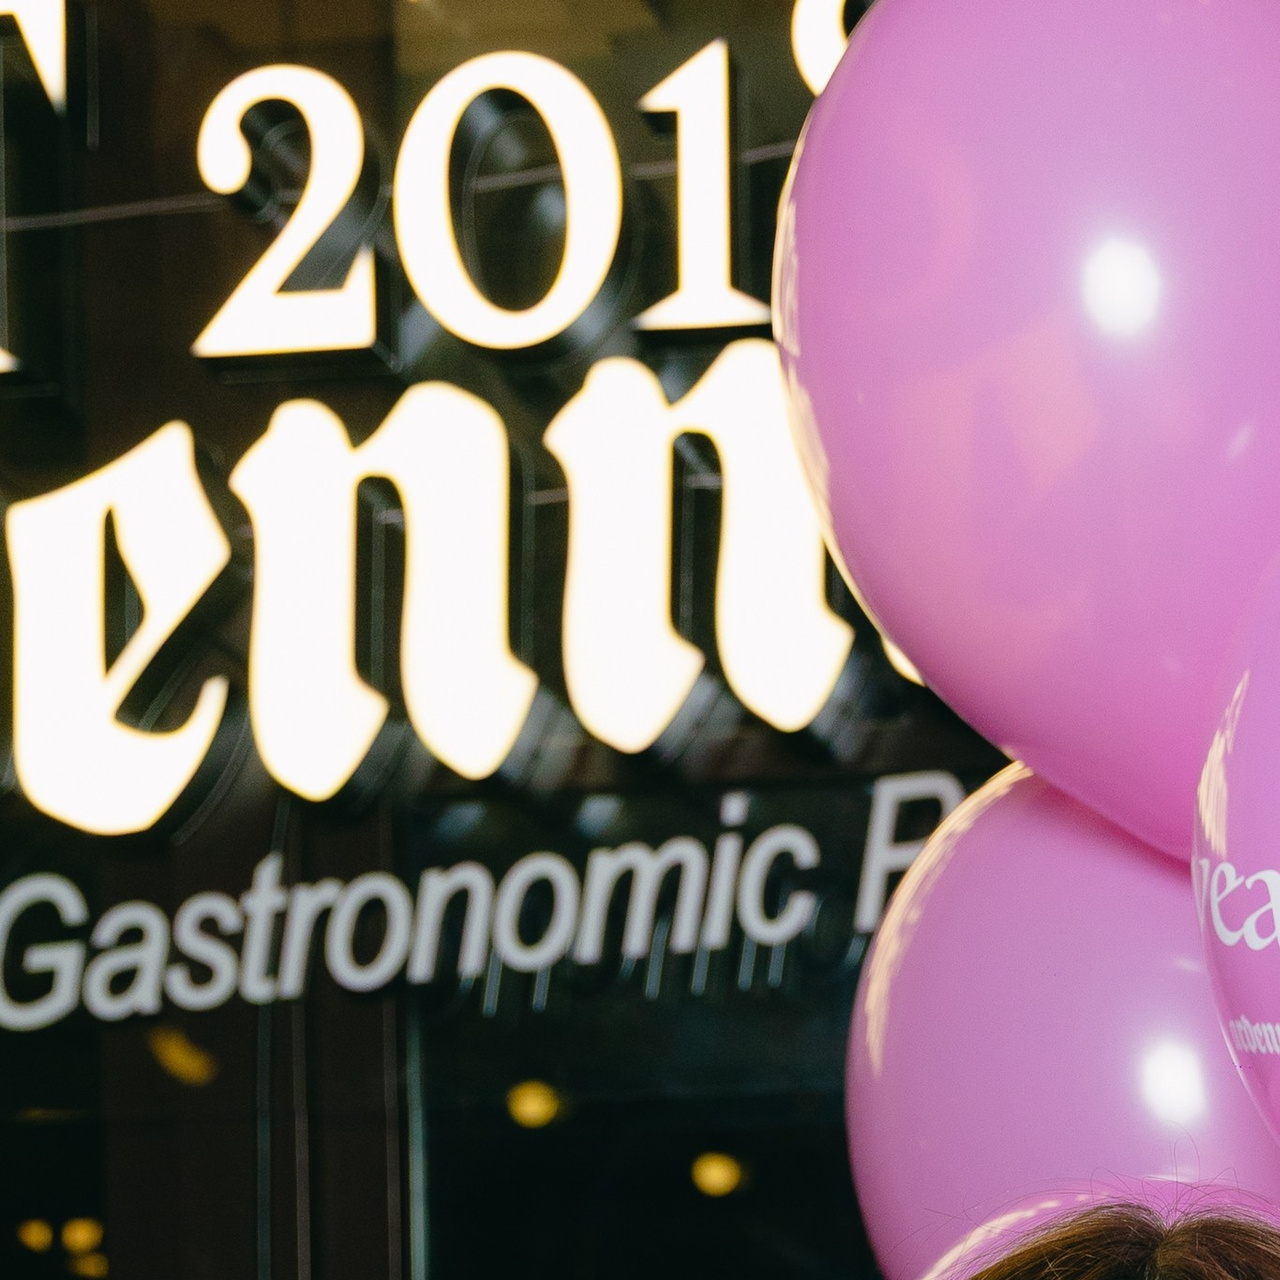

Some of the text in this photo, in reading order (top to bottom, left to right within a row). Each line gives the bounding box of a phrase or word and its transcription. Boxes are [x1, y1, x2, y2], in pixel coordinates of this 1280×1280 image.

[192, 0, 857, 354] 201
[6, 337, 926, 836] enn
[0, 794, 822, 1031] Gastronomic
